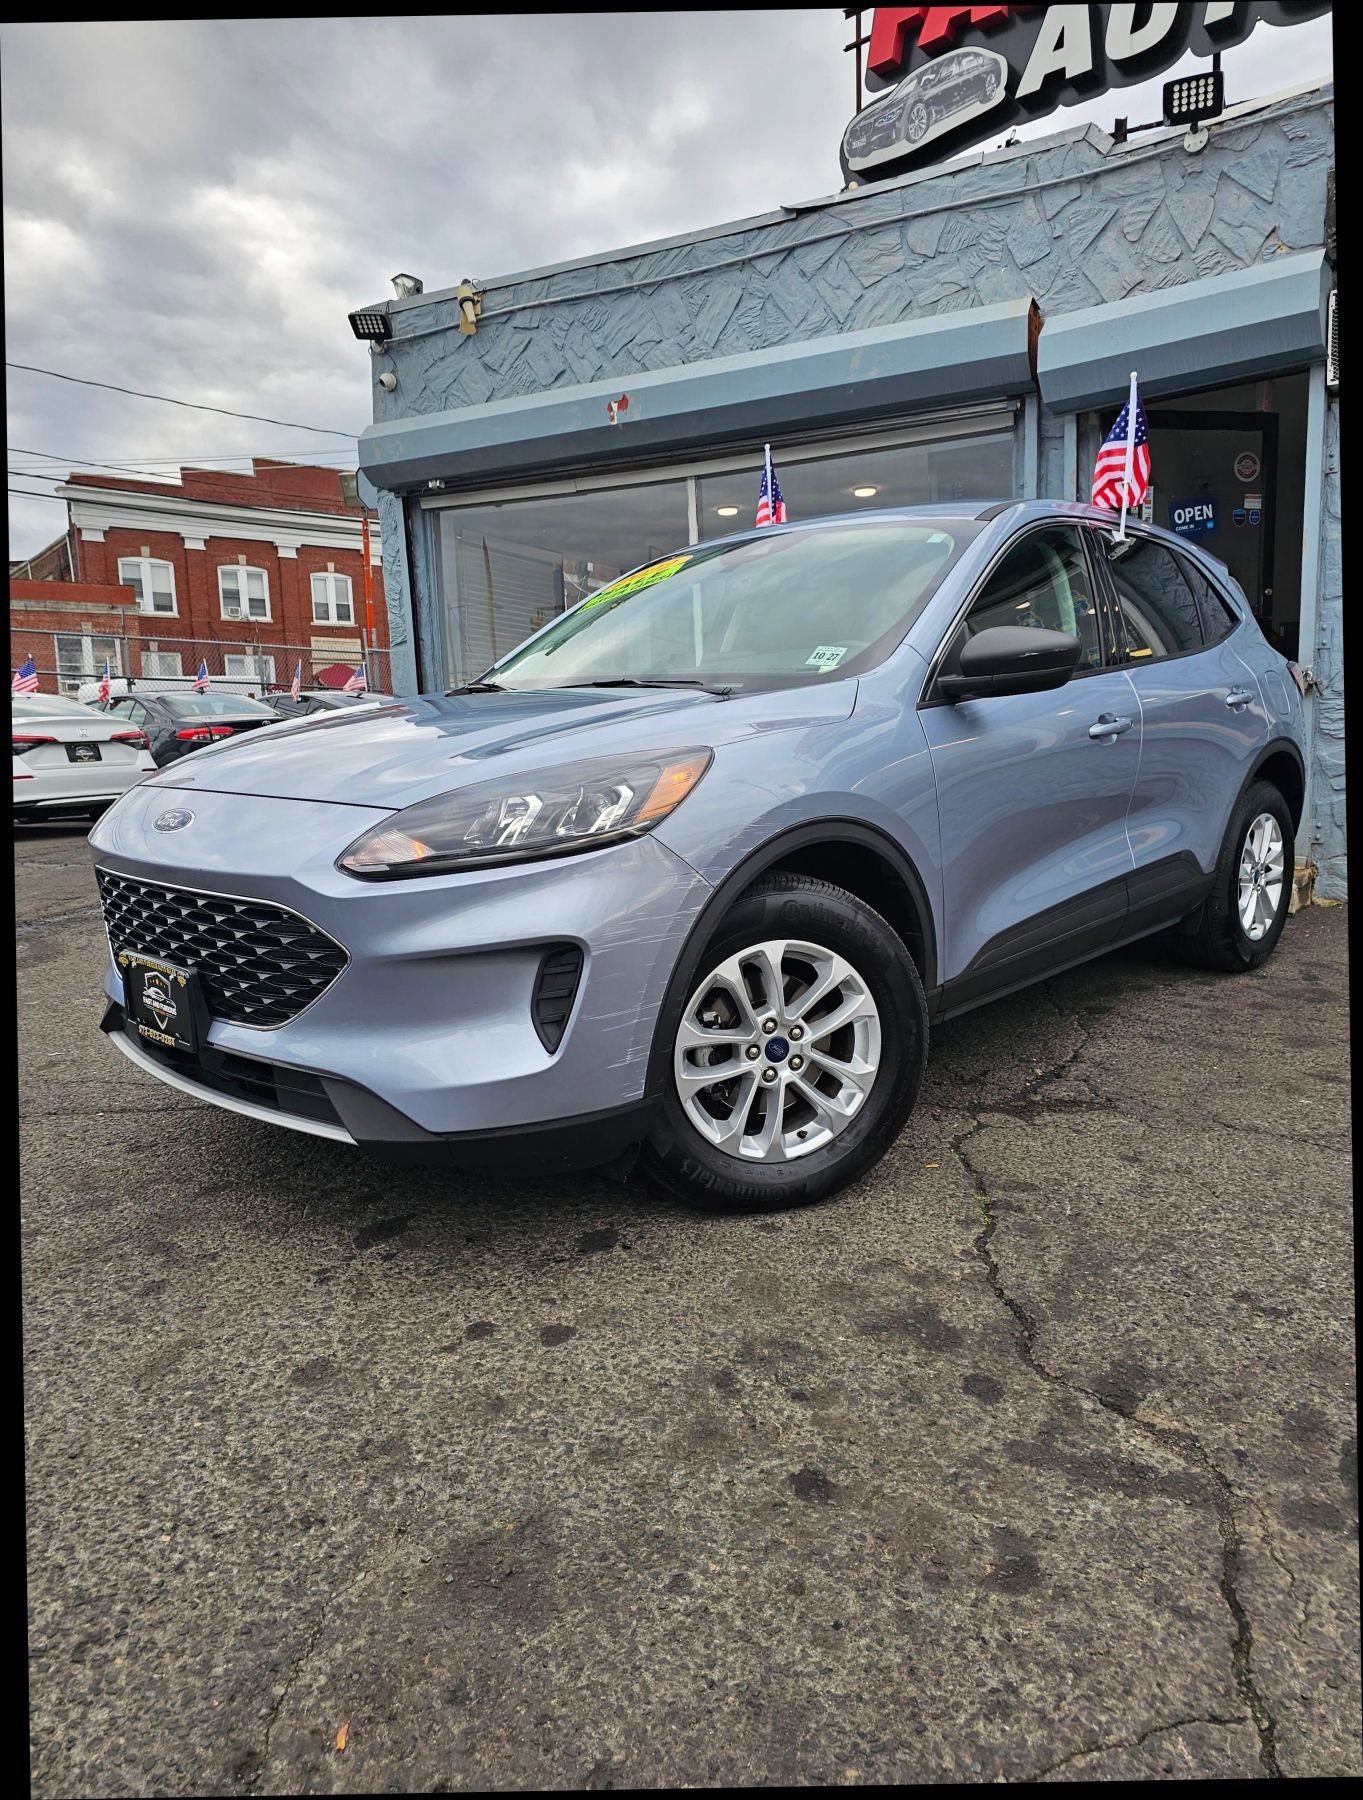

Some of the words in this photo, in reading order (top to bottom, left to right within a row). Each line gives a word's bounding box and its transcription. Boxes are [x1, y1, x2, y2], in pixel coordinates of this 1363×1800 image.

[1174, 503, 1213, 524] OPEN
[812, 651, 826, 659] 10
[826, 653, 840, 661] 27
